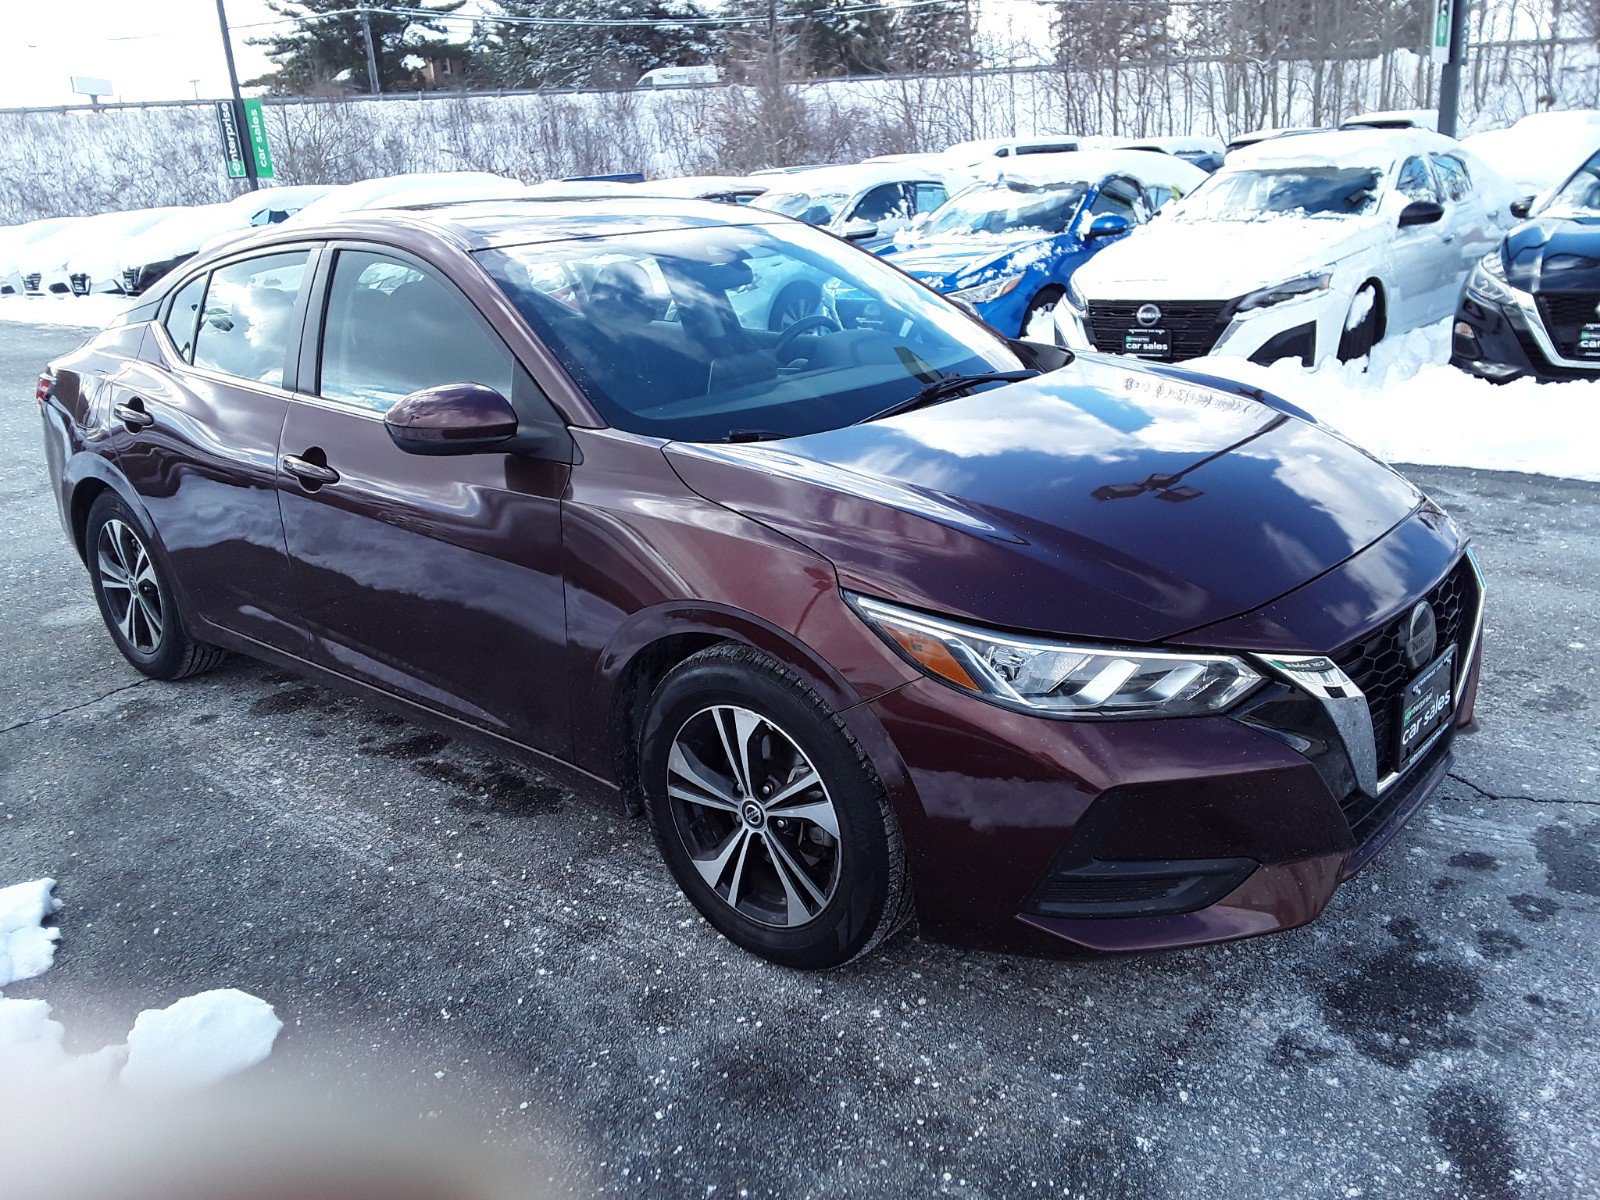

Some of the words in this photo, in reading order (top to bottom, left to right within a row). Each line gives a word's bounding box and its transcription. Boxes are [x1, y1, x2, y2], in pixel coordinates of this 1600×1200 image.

[220, 102, 241, 176] enterprise
[251, 109, 262, 143] sales
[257, 147, 267, 168] car
[1142, 342, 1168, 350] sales
[1402, 716, 1424, 746] car
[1423, 688, 1451, 726] sales
